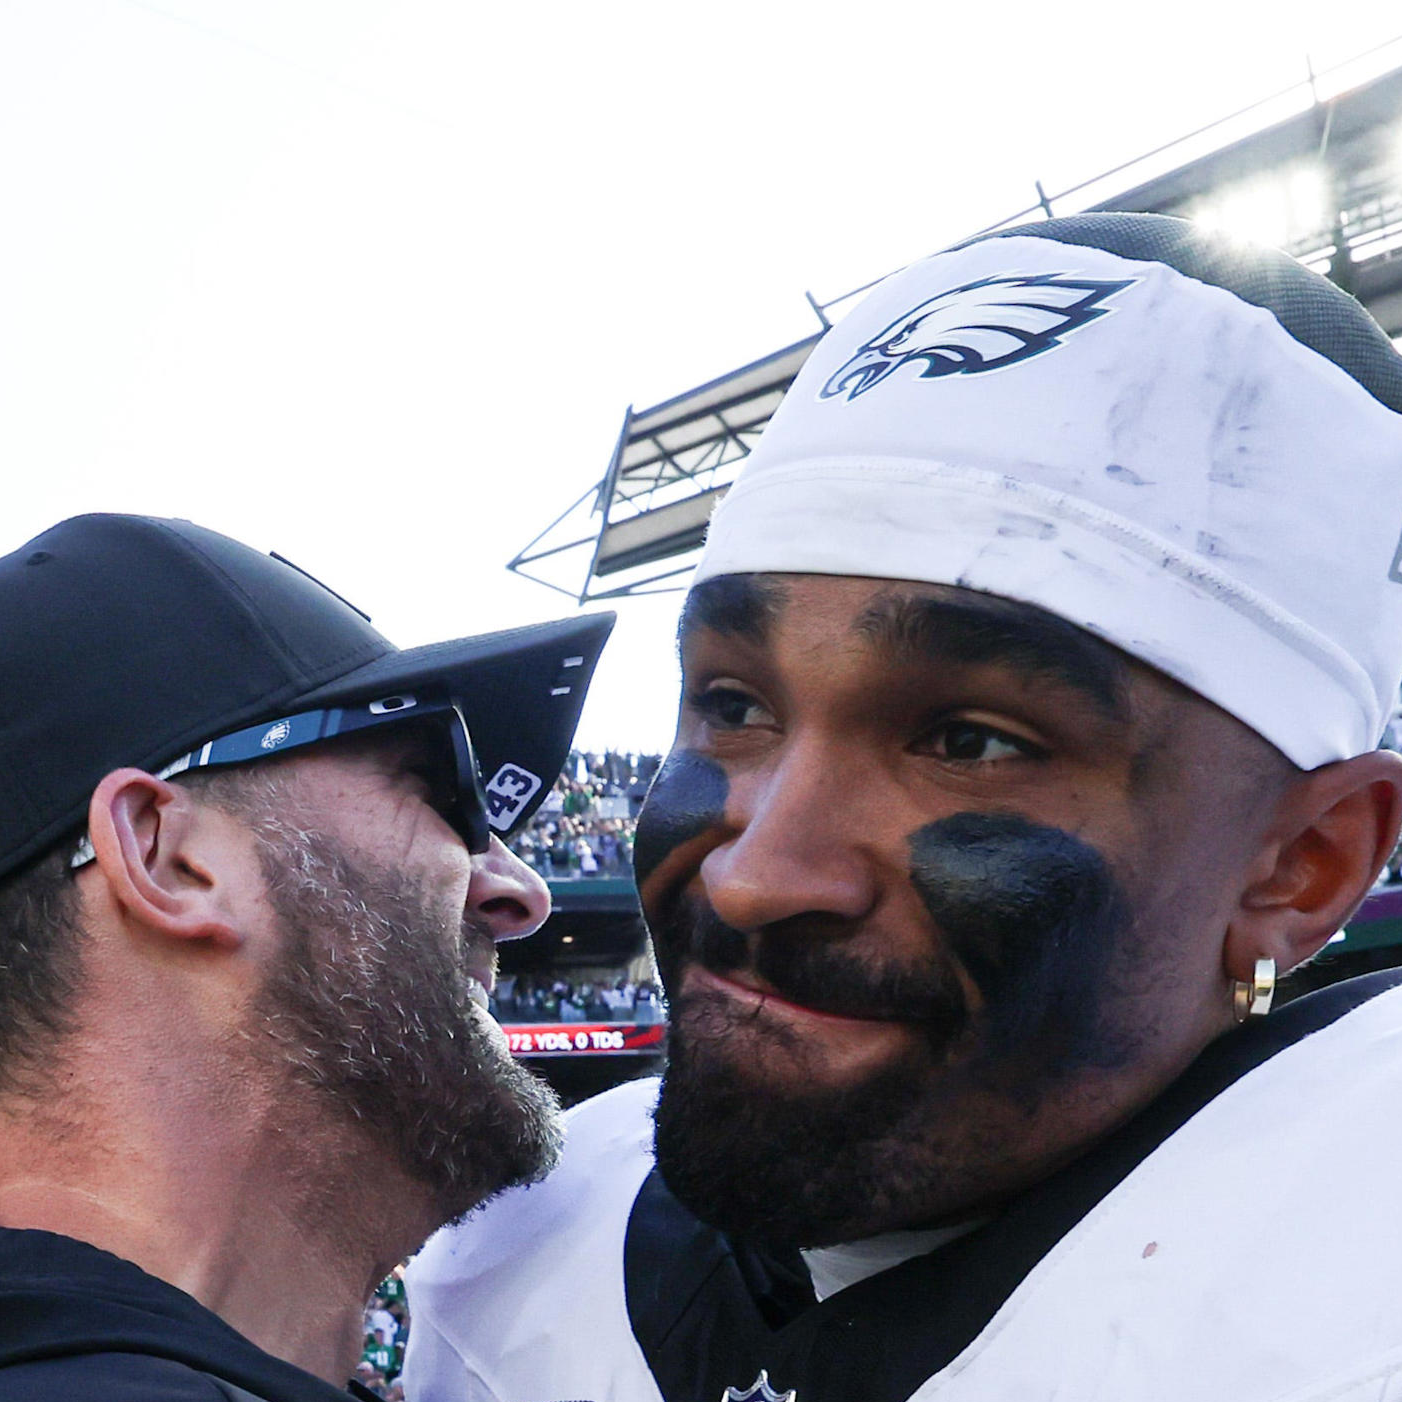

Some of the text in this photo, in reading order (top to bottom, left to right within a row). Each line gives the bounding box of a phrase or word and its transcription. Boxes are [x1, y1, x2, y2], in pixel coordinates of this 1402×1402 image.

[487, 768, 533, 818] 43
[574, 1032, 589, 1049] 0
[590, 1031, 624, 1048] TDS
